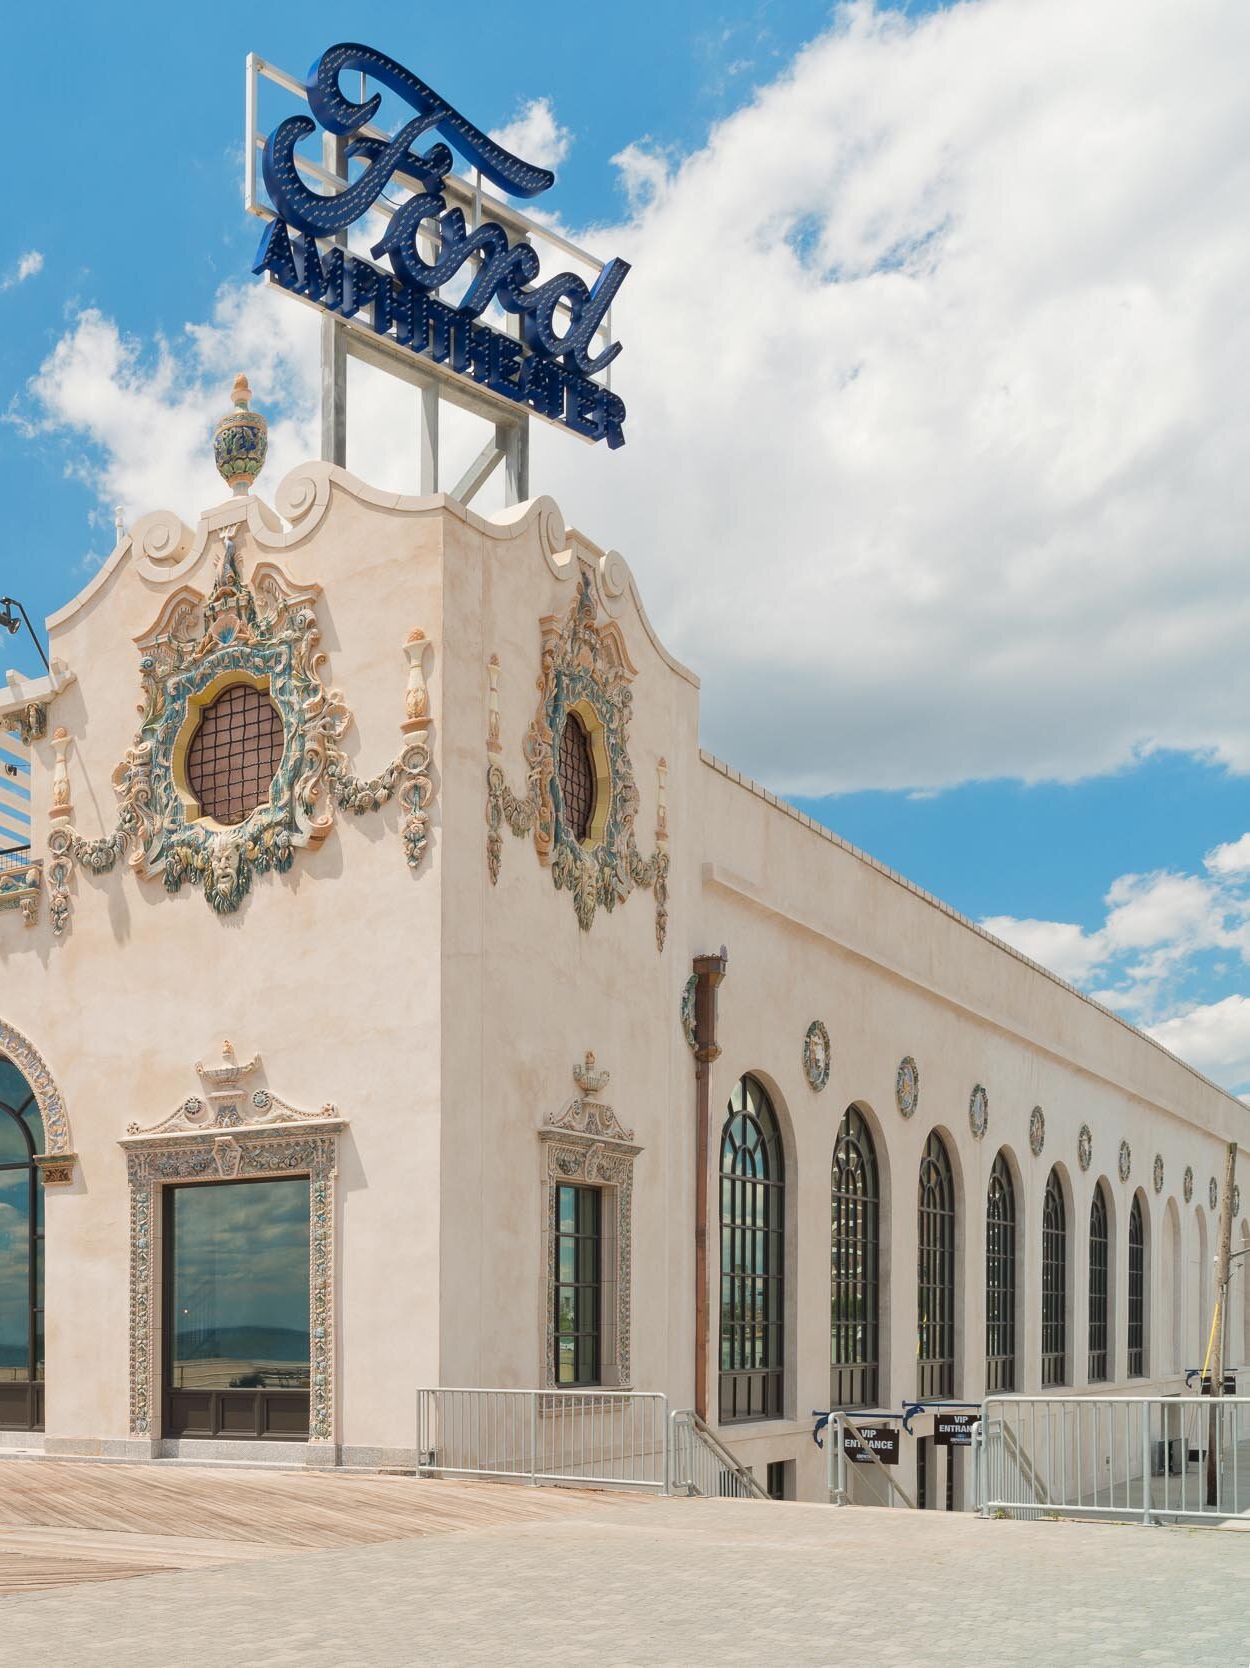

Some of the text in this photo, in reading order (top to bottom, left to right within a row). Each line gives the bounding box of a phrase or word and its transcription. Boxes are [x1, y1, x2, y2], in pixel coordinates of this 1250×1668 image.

[262, 42, 632, 377] Ford
[251, 217, 627, 450] AMPHITHEATER
[953, 1415, 969, 1424] VIP
[861, 1429, 877, 1438] VIP
[939, 1424, 983, 1433] ENTRANE
[844, 1439, 894, 1450] ENTANCE
